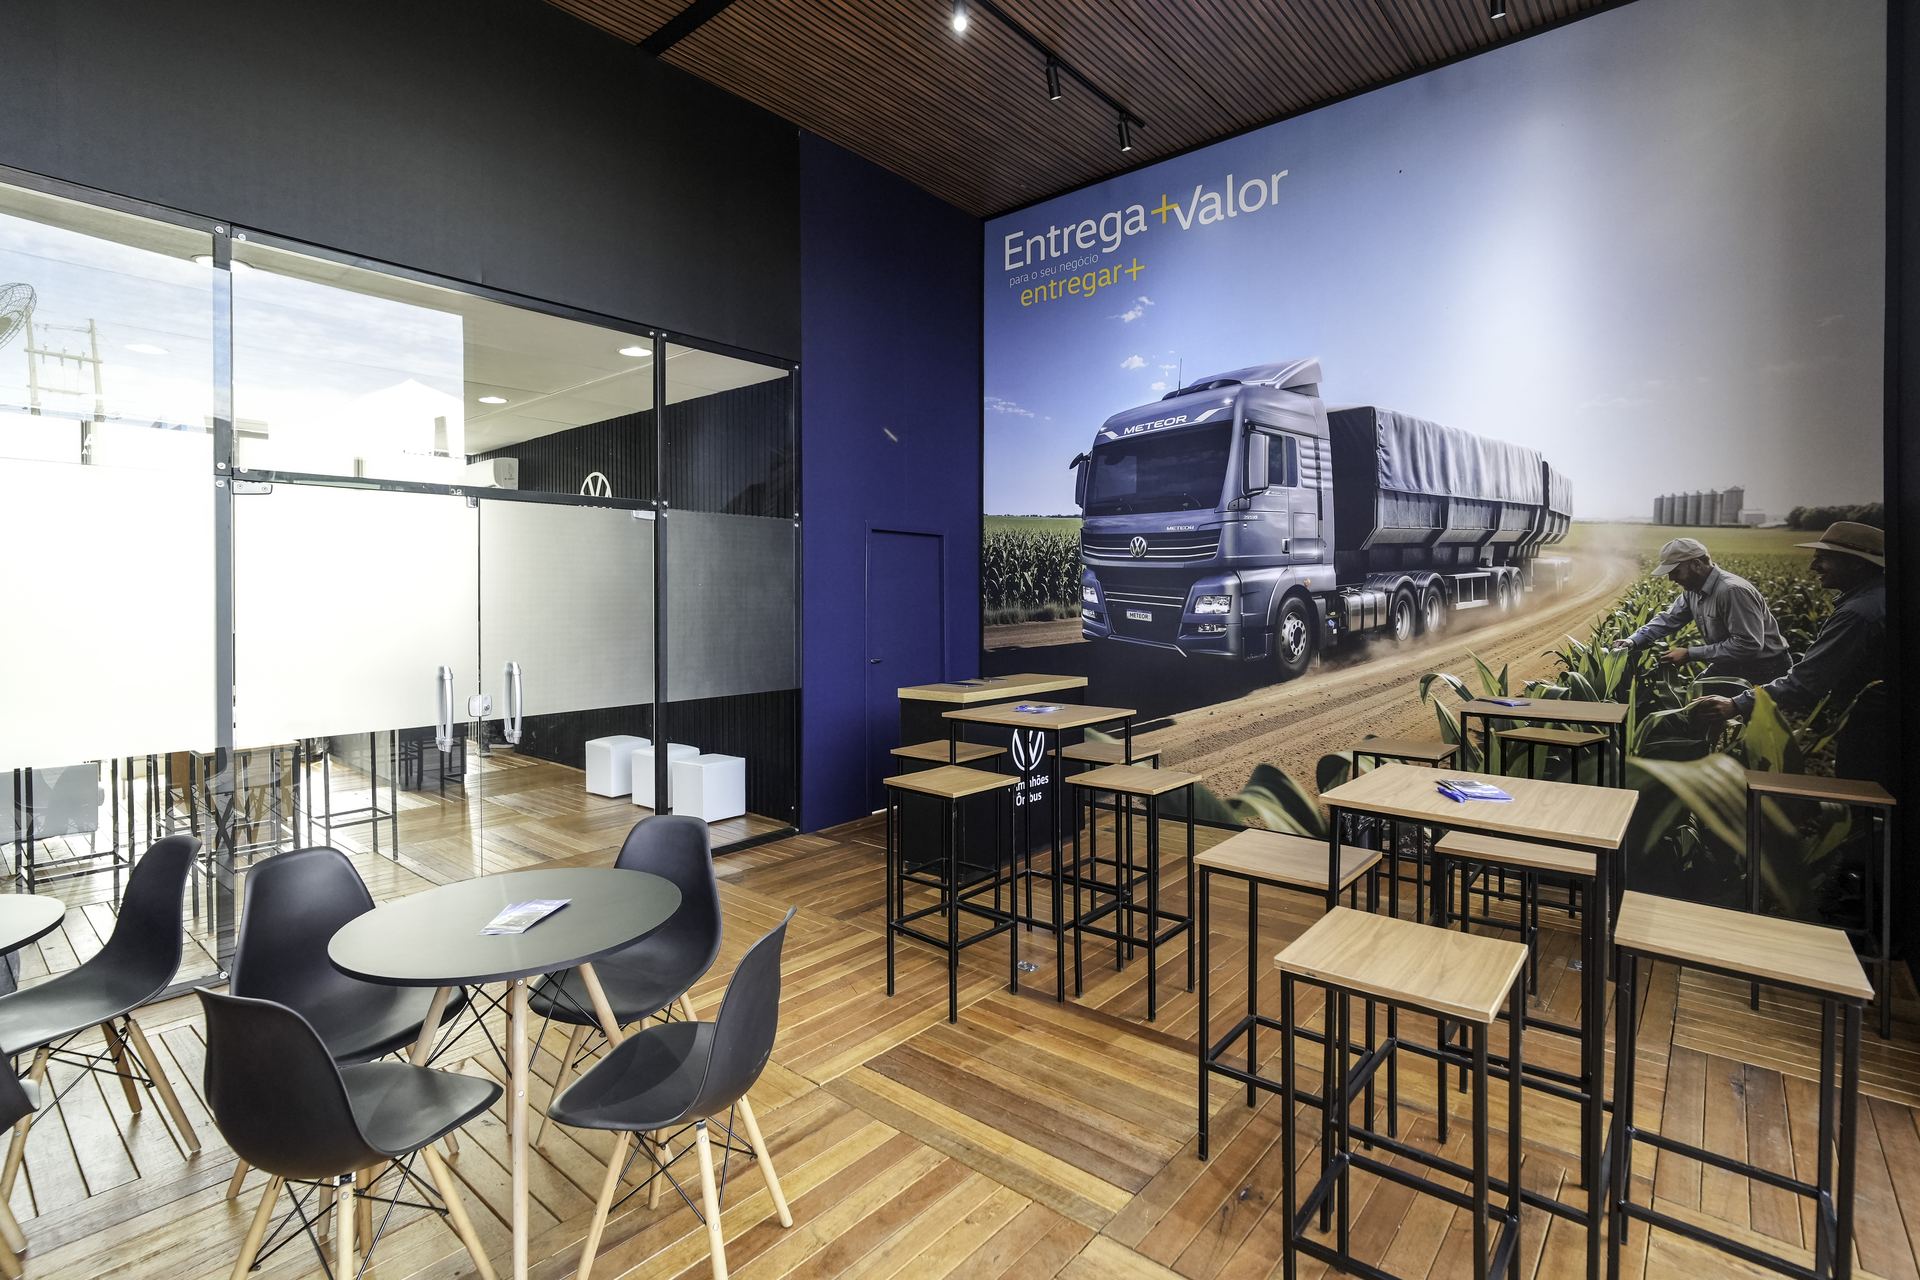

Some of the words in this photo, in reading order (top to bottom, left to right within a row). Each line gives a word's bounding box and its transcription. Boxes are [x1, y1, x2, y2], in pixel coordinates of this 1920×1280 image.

[1004, 203, 1148, 271] Entrega
[1009, 273, 1029, 288] para
[1031, 271, 1038, 280] o
[1040, 266, 1057, 278] seu
[1059, 253, 1099, 272] negócio
[1123, 414, 1188, 435] METEOR
